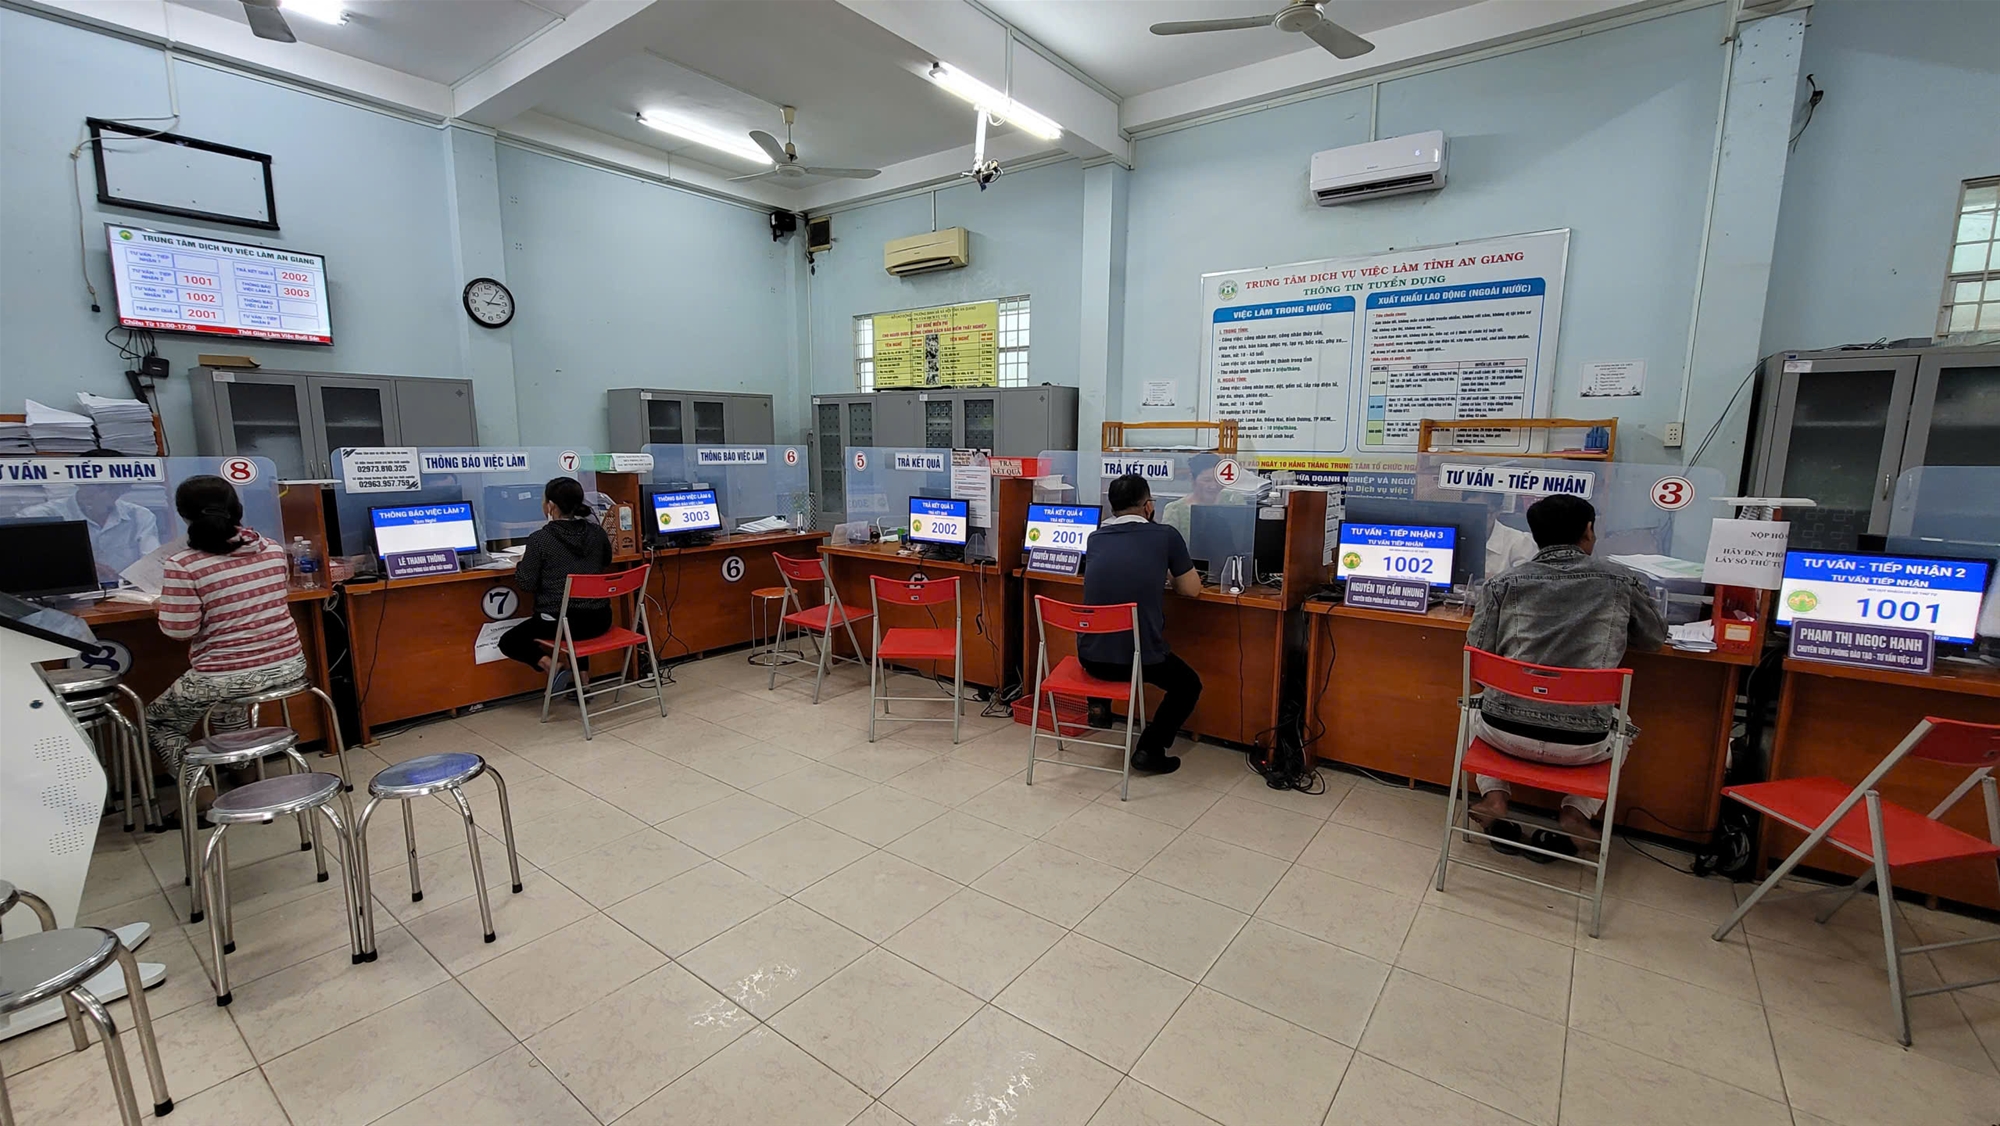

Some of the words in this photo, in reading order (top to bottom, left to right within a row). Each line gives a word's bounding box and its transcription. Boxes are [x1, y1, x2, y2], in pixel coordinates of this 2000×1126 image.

[142, 234, 173, 245] TRUNG
[177, 239, 196, 248] TÂM
[198, 242, 219, 252] DỊCH
[235, 247, 254, 257] VIỆC
[257, 251, 274, 259] LÀM
[277, 253, 288, 261] AN
[291, 255, 314, 265] GIANG
[281, 272, 308, 282] 2002
[1245, 279, 1280, 290] TRUNG
[1284, 275, 1306, 285] TÂM
[1310, 272, 1337, 283] DỊCH
[1341, 270, 1356, 279] VỤ
[1360, 265, 1389, 278] VIỆC
[1392, 262, 1420, 274] LÀM
[1423, 257, 1455, 271] TỈNH
[1457, 256, 1477, 267] AN
[1480, 251, 1525, 265] GIANG
[184, 275, 212, 286] 1001
[1303, 284, 1341, 296] THÔNG
[1344, 283, 1364, 292] TIN
[1367, 275, 1407, 290] TUYỂN
[1411, 275, 1446, 286] DỤNG
[186, 293, 215, 303] 1002
[284, 287, 310, 297] 3003
[1378, 295, 1398, 305] XUẤT
[1400, 292, 1423, 303] KHẨU
[1425, 291, 1444, 300] LAO
[1445, 288, 1466, 300] ĐỘNG
[1468, 287, 1500, 298] (NGOÀI
[1502, 284, 1531, 294] NƯỚC)
[188, 309, 216, 319] 2001
[1233, 309, 1253, 319] VIỆC
[1255, 307, 1273, 317] LÀM
[1275, 305, 1304, 314] TRONG
[1306, 302, 1332, 312] NƯỚC
[425, 455, 458, 468] THÔNG
[462, 455, 481, 468] BÁO
[483, 454, 503, 470] VIỆC
[506, 454, 525, 467] LÀM
[563, 456, 575, 469] 7
[700, 450, 721, 461] THÔNG
[723, 450, 736, 461] BÁO
[737, 450, 750, 463] VIỆC
[752, 450, 764, 460] LÀM
[787, 451, 795, 462] 6
[857, 455, 864, 467] 5
[898, 455, 910, 467] TRẢ
[912, 455, 924, 467] KẾT
[926, 456, 940, 468] QUẢ
[9, 460, 48, 480] VẤN
[65, 460, 103, 479] TIẾP
[109, 462, 156, 481] NHẬN
[229, 461, 251, 480] 8
[1104, 459, 1122, 474] TRẢ
[1126, 460, 1144, 475] KẾT
[1147, 461, 1168, 476] QUẢ
[1220, 464, 1234, 480] 4
[1261, 461, 1278, 469] NGÀY
[1308, 461, 1329, 469] THÁNG
[1355, 461, 1369, 470] TÂM
[1372, 461, 1381, 470] TỔ
[1383, 462, 1402, 471] CHỨC
[359, 480, 410, 488] 02963.957.759
[1342, 476, 1374, 484] NGHIỆP
[1377, 476, 1389, 484] VÀ
[1446, 469, 1465, 485] TƯ
[1467, 467, 1494, 487] VẤN
[1508, 470, 1539, 490] TIẾP
[1390, 486, 1408, 494] việc
[1658, 482, 1683, 504] 3
[379, 510, 407, 518] THÔNG
[409, 509, 424, 517] BÁO
[425, 508, 442, 516] VIỆC
[682, 511, 709, 522] 3003
[1067, 509, 1077, 517] QUẢ
[932, 522, 957, 535] 2002
[1410, 531, 1436, 539] NHẬN
[1053, 531, 1083, 544] 2001
[398, 556, 406, 565] LÊ
[406, 556, 426, 565] THANH
[427, 554, 446, 563] THÔNG
[1383, 556, 1433, 574] 1002
[726, 558, 740, 578] 6
[1802, 558, 1826, 567] TƯ
[1827, 558, 1855, 570] VẤN
[1869, 560, 1902, 572] TIẾP
[1906, 564, 1953, 577] NHẬN
[1955, 568, 1966, 578] 2
[1832, 574, 1848, 582] TƯ
[1848, 575, 1870, 584] VẤN
[1871, 576, 1895, 585] TIẾP
[1896, 579, 1929, 588] NHẬN
[1351, 581, 1375, 593] NGUYỄN
[1376, 585, 1386, 596] THỊ
[1387, 583, 1401, 595] CẨM
[1402, 587, 1424, 598] NHUNG
[489, 591, 510, 614] 7
[1857, 598, 1941, 624] 1001
[1800, 628, 1832, 643] PHẠM
[1835, 631, 1852, 648] THỊ
[1855, 633, 1887, 650] NGỌC
[1890, 637, 1923, 652] HẠNH
[1797, 645, 1818, 654] CHUYÊN
[1831, 648, 1849, 657] PHÒNG
[1850, 649, 1861, 659] ĐÀO
[1862, 651, 1872, 661] TẠO
[1876, 653, 1884, 661] TƯ
[1885, 653, 1897, 663] VẤN
[1897, 655, 1910, 665] VIỆC
[1911, 655, 1923, 665] LÀM
